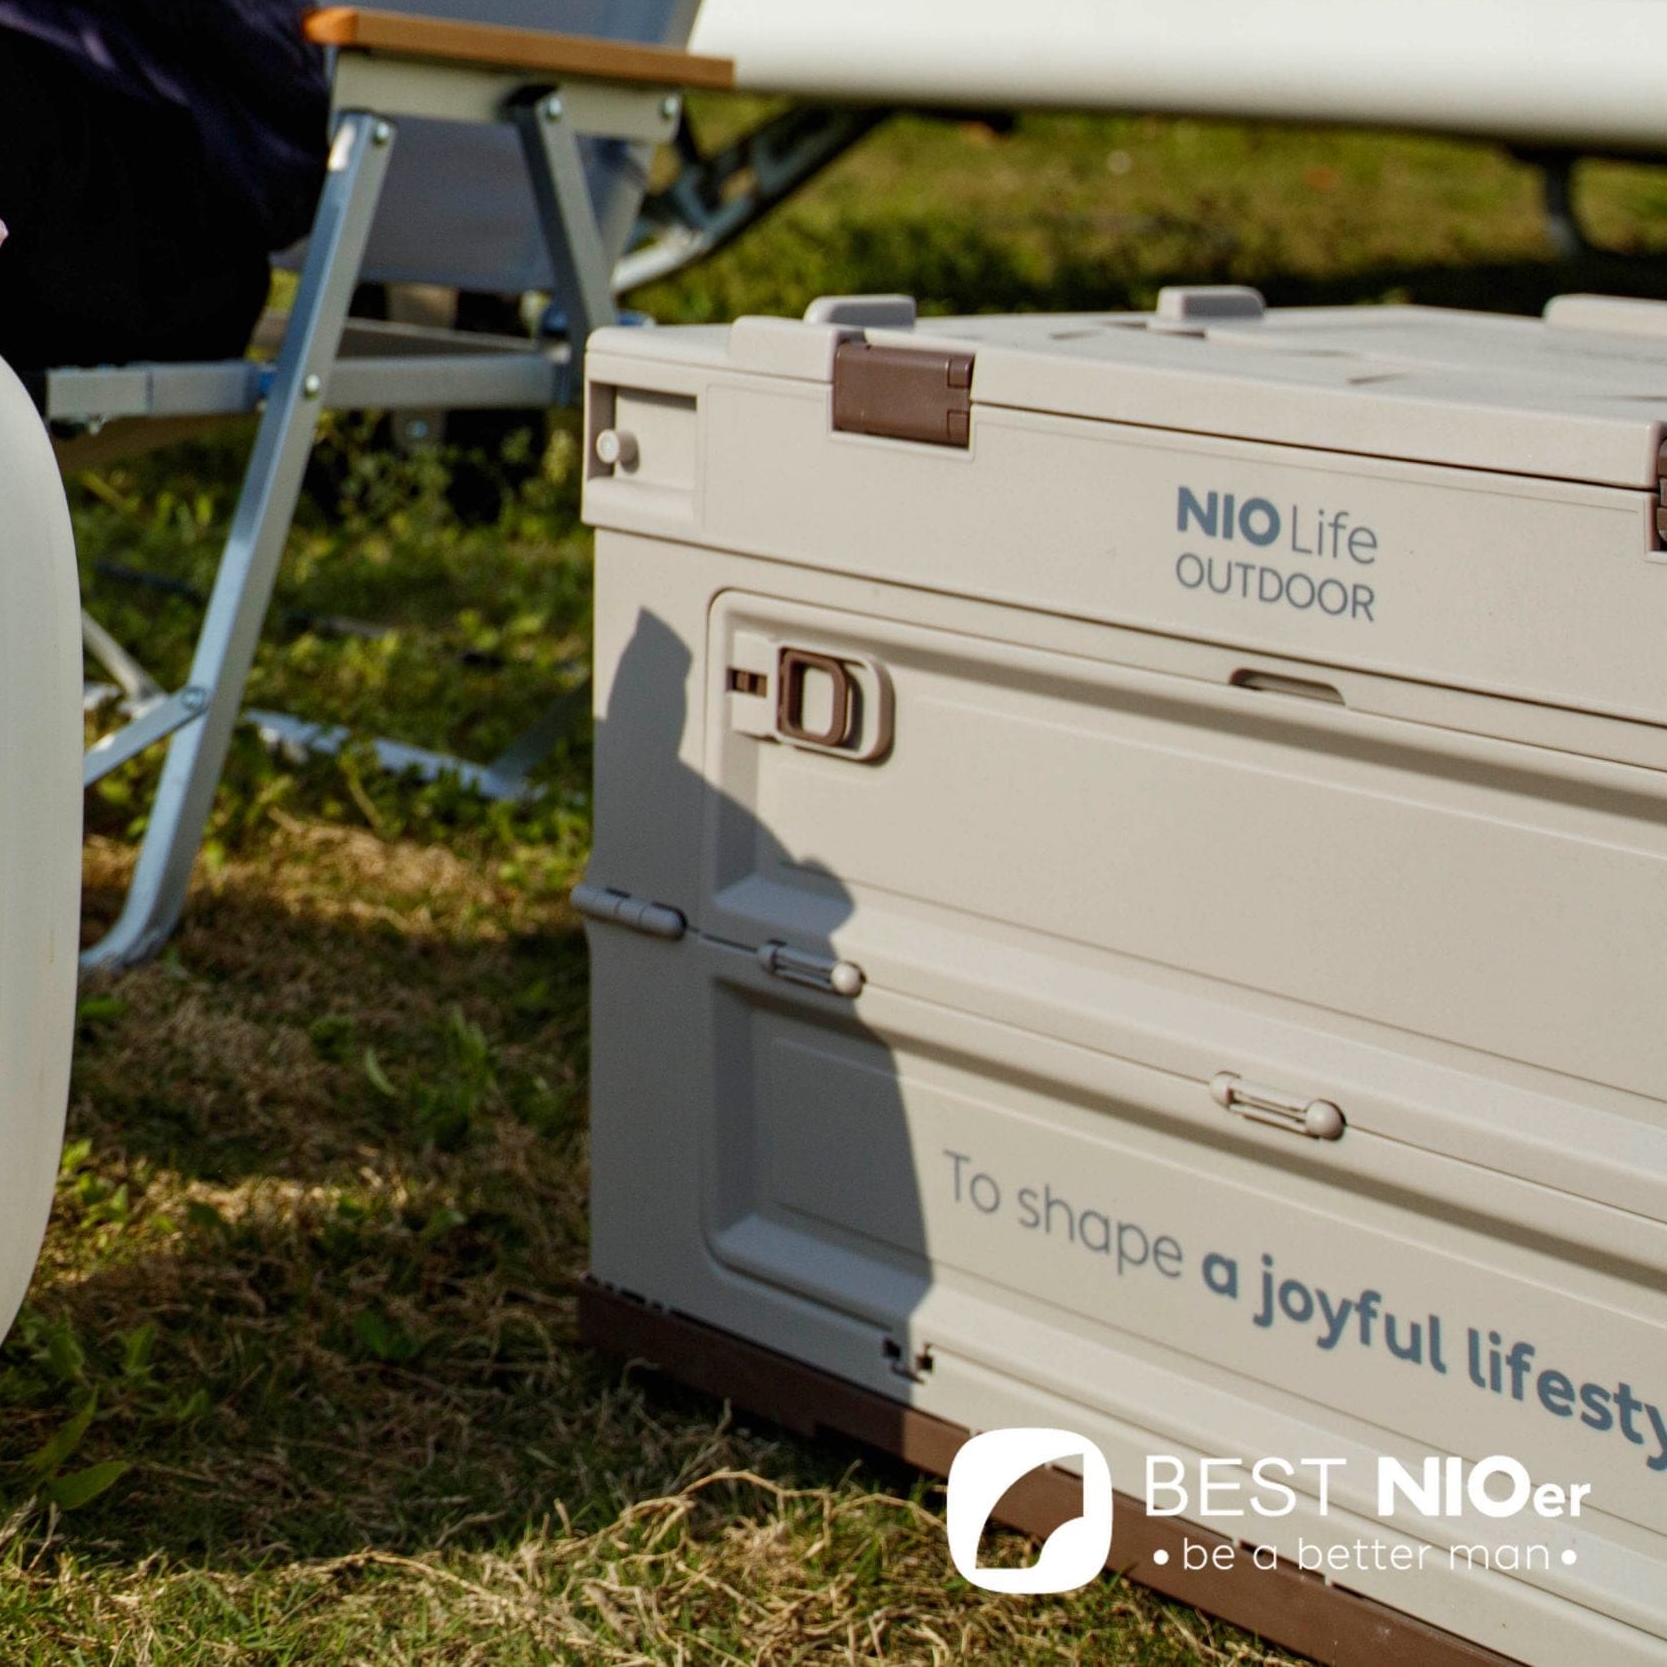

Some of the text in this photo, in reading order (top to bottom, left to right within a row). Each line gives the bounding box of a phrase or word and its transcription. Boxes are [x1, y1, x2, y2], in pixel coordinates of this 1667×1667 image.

[1177, 486, 1378, 565] NIO Life
[1176, 552, 1375, 622] OUTDOOR
[943, 1149, 1000, 1213] To
[1017, 1185, 1183, 1278] shape
[1202, 1252, 1238, 1299] a
[1253, 1253, 1447, 1374] joyful
